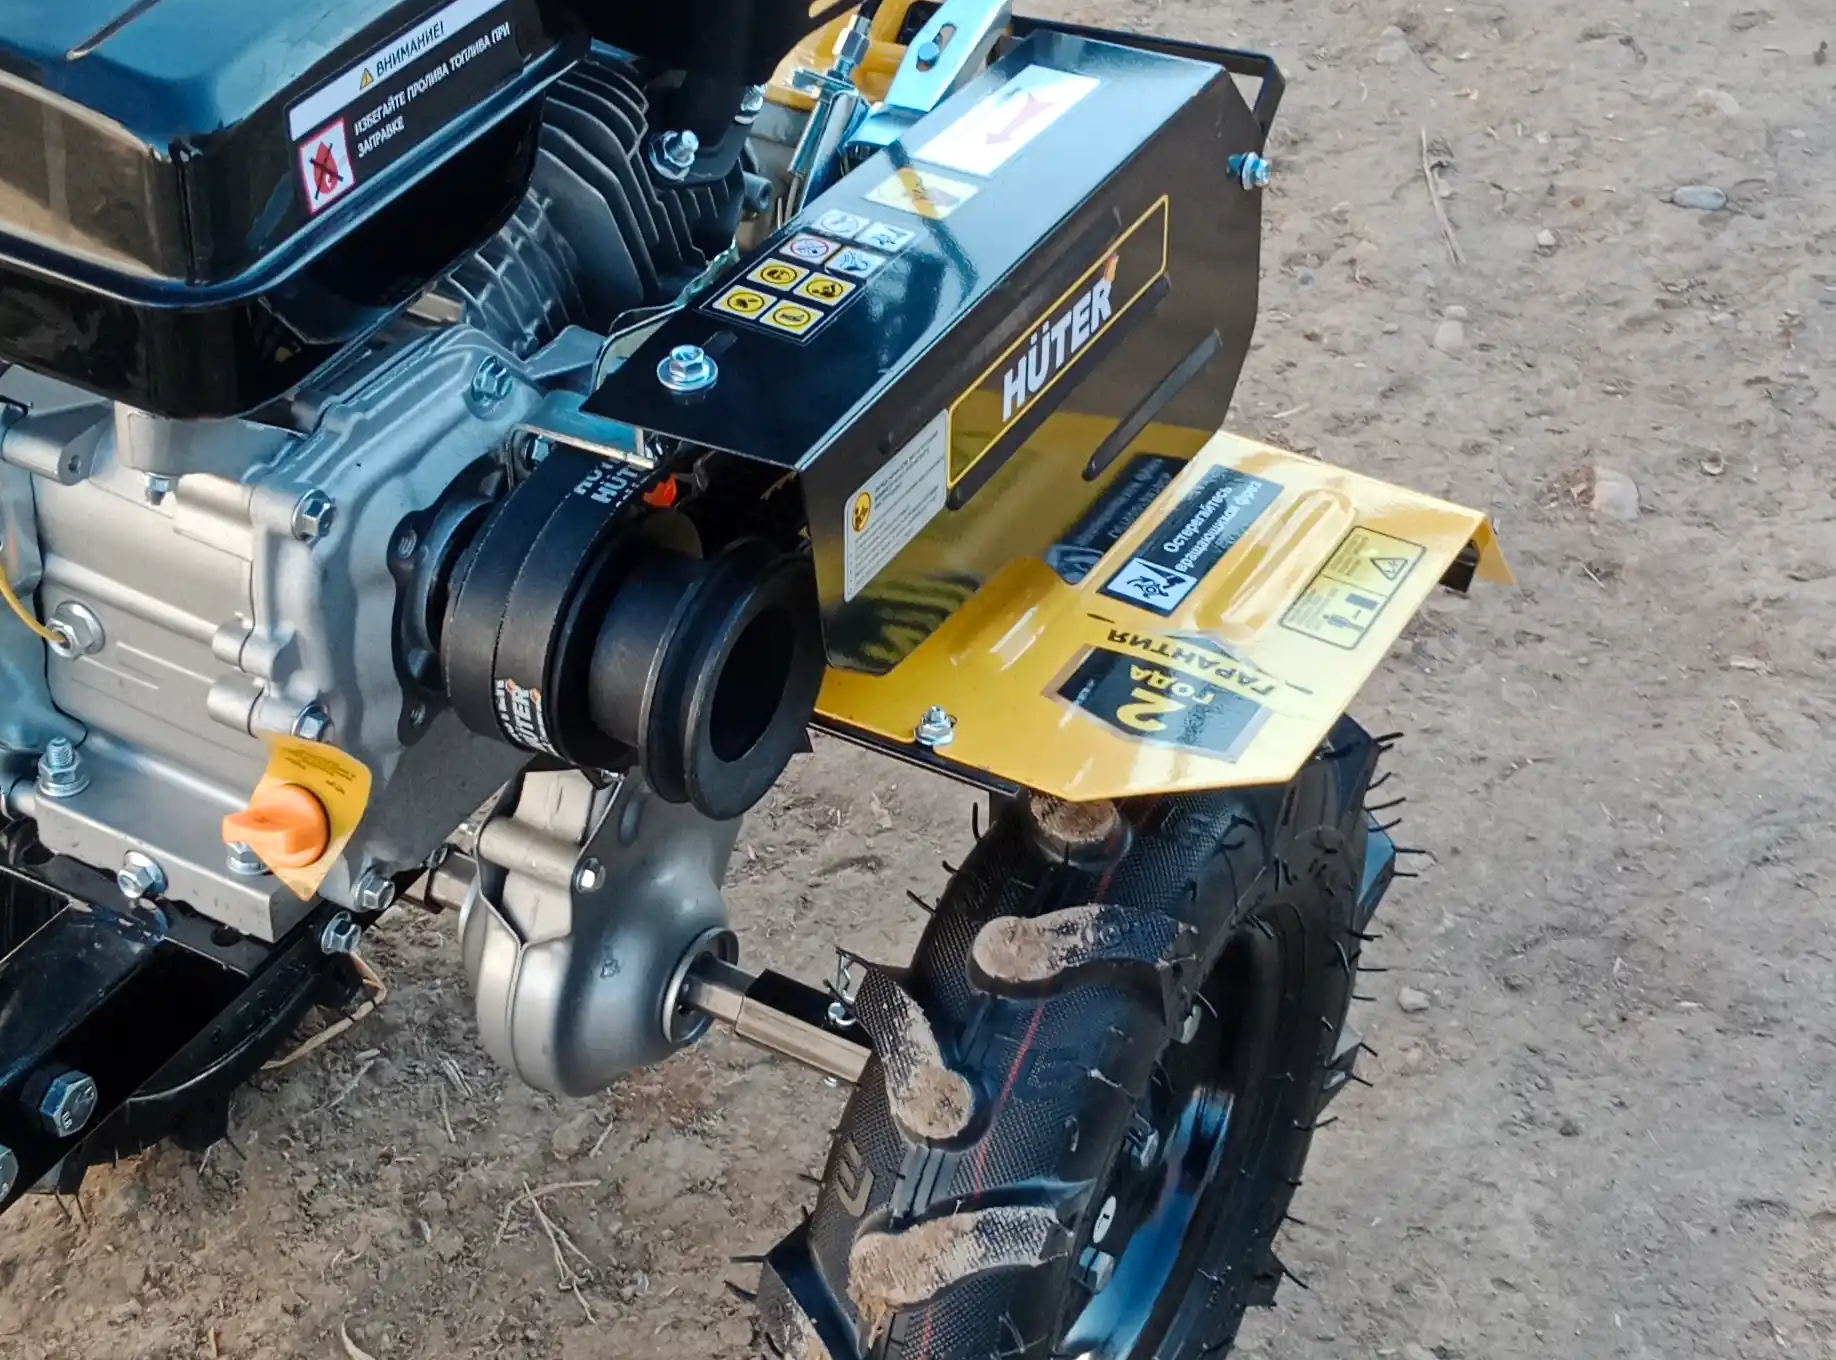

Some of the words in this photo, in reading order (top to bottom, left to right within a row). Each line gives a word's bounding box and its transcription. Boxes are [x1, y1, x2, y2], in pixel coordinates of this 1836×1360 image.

[376, 20, 445, 77] ВНИМАНИЕ!
[354, 94, 406, 136] ИЗБЕГАЙТЕ
[407, 65, 449, 103] ПРОЛИВА
[449, 37, 491, 72] ТОПЛИВА
[491, 20, 511, 45] ПРИ
[357, 115, 405, 159] ЗАПРАВКЕ
[1002, 273, 1113, 423] HÜTER
[590, 466, 646, 504] HÜT
[1163, 486, 1233, 553] Остерегайтесь
[1107, 628, 1276, 696] ГАРАНТИЯ
[1130, 664, 1216, 705] ГОДА
[1116, 687, 1187, 732] 2
